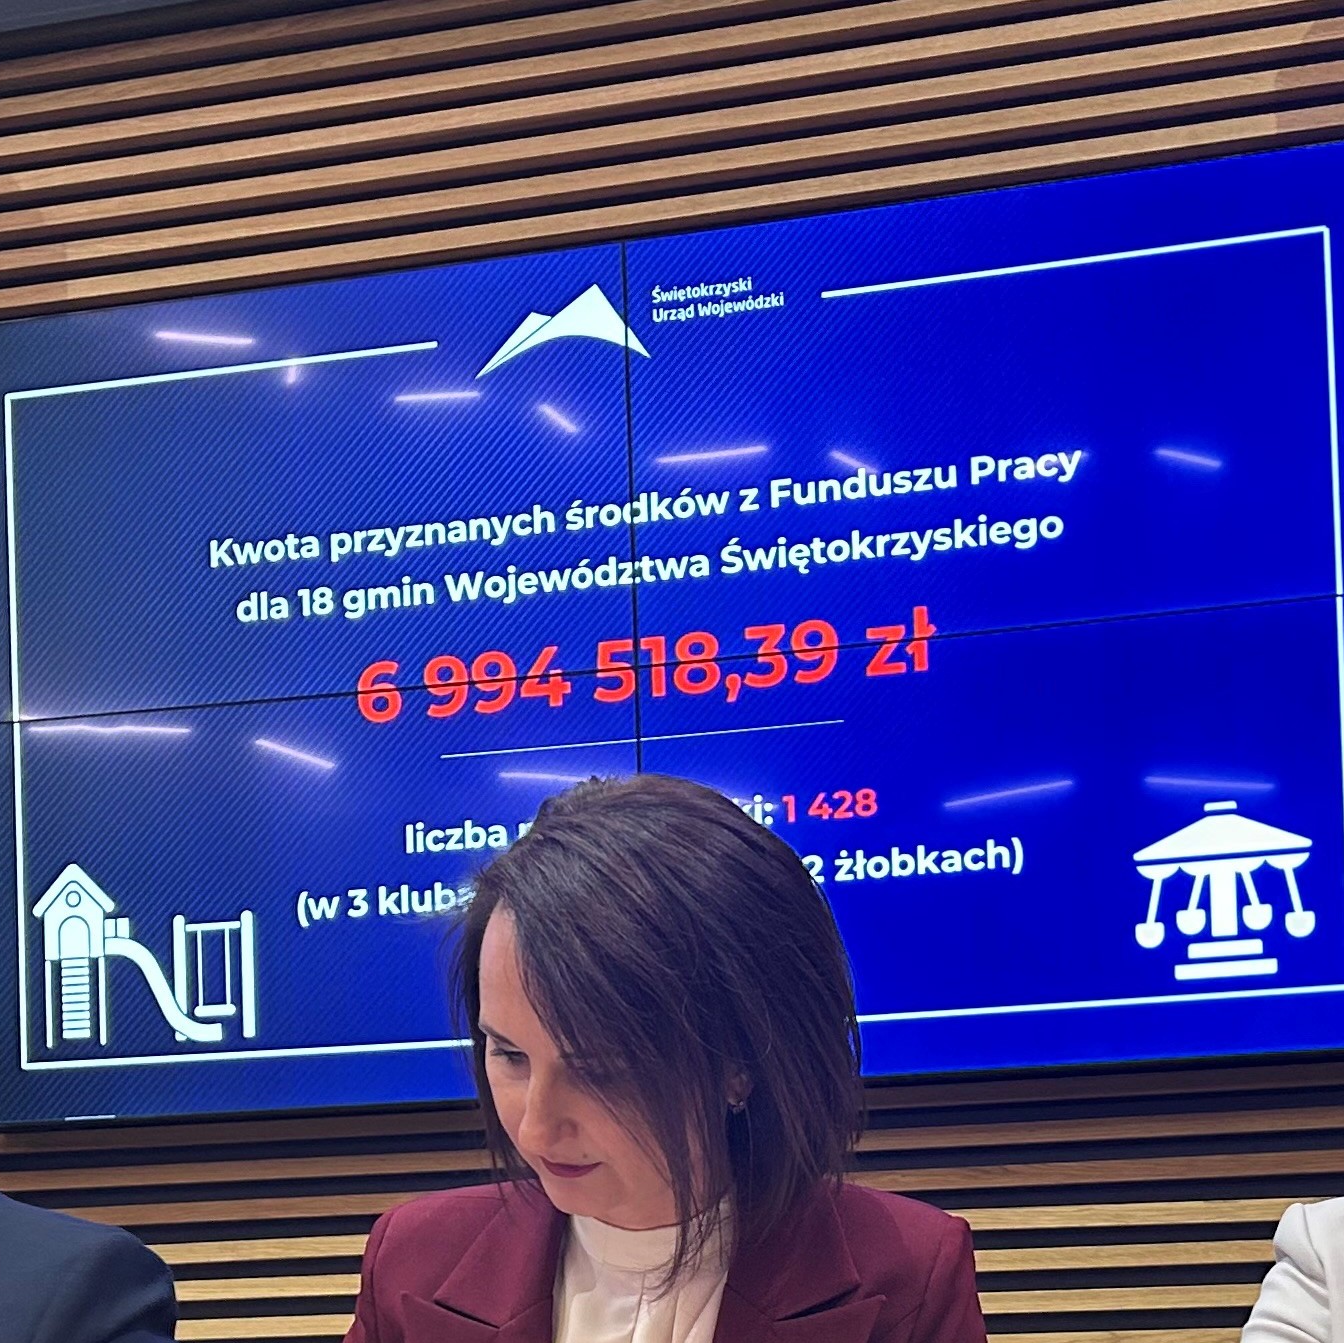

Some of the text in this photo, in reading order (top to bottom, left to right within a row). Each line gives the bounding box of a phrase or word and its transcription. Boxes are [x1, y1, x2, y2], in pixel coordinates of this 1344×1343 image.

[651, 276, 753, 304] Świętokrzyski
[652, 291, 785, 323] Urząd Wojewódzki
[209, 449, 1083, 569] Kwota przyznanych środków z Funduszu Pracy
[236, 515, 1064, 623] dla 18 gmin Województwa Świętokrzyskiego
[357, 605, 937, 724] 6 994 518,39 zł
[405, 819, 509, 854] liczba
[781, 795, 796, 823] 1
[807, 788, 878, 820] 428
[297, 890, 341, 928] (w
[347, 888, 369, 918] 3
[834, 836, 1024, 882] żłobkach)
